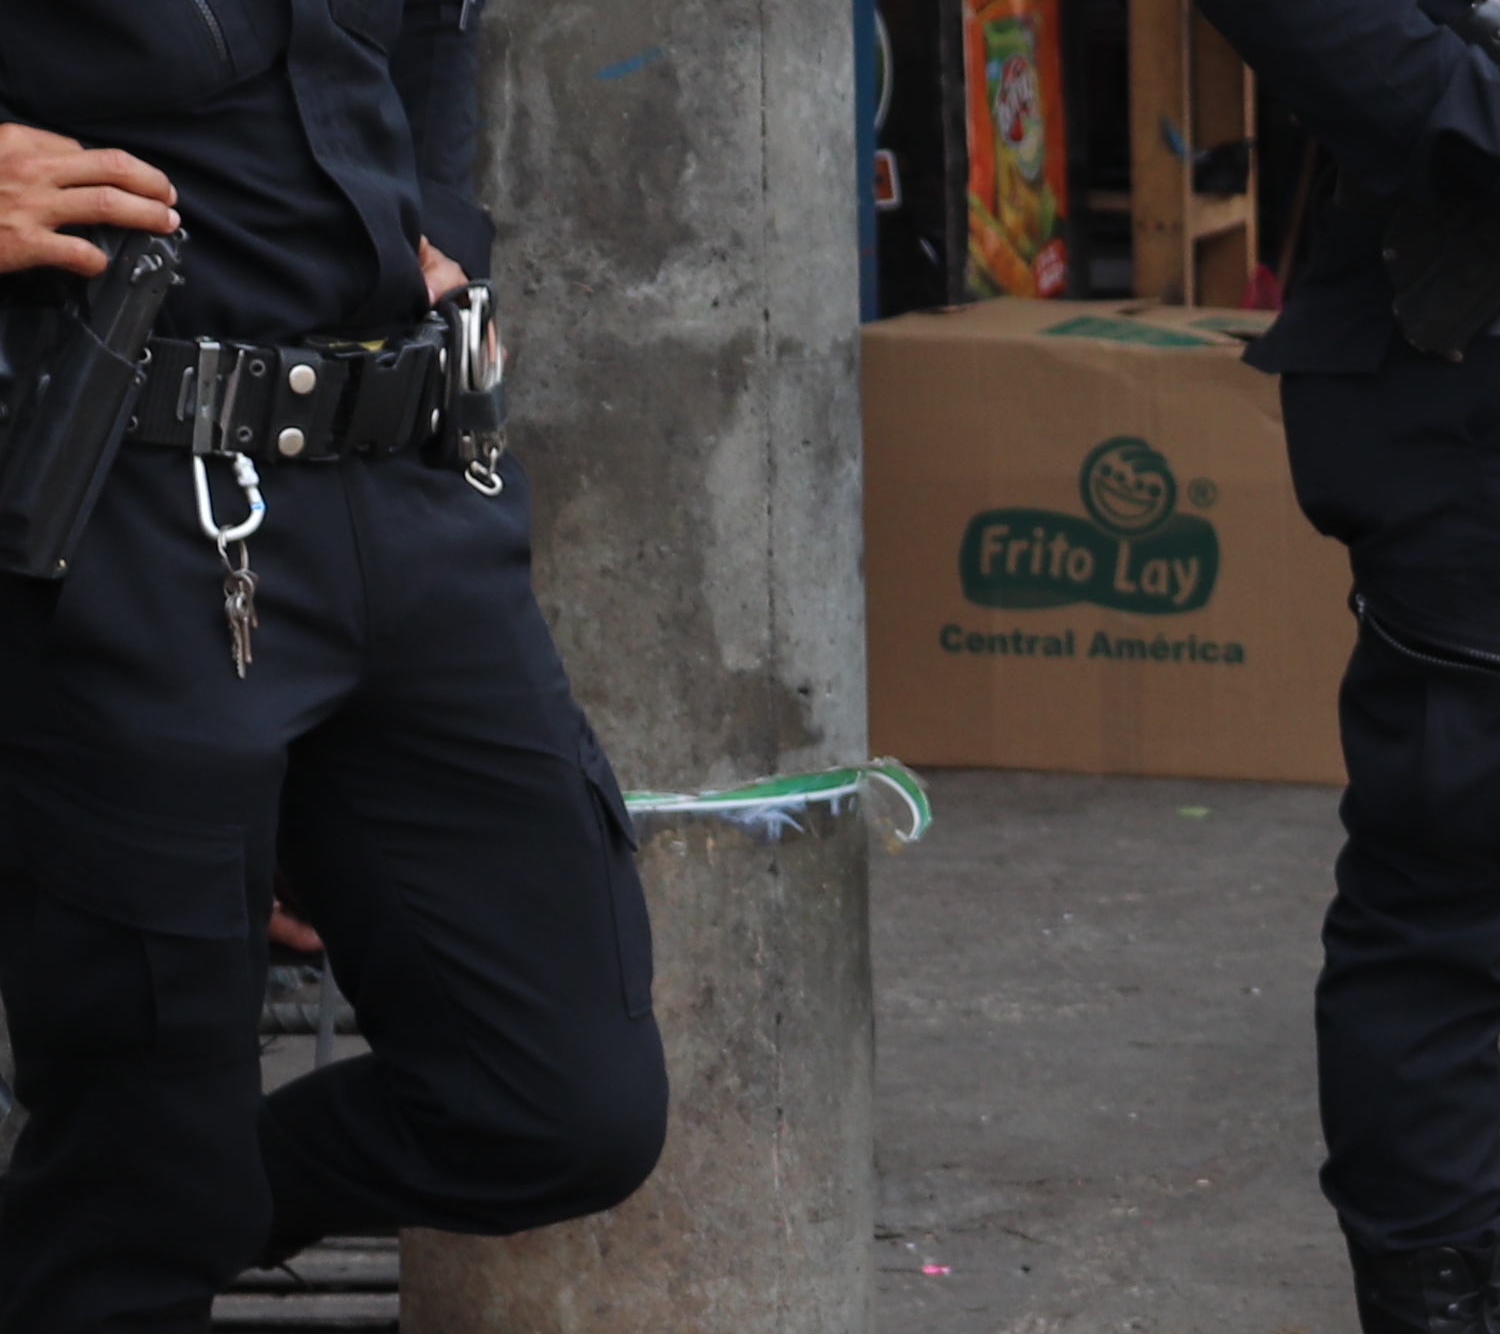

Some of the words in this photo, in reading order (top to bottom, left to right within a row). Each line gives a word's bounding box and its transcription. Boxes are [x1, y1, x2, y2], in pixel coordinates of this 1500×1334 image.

[979, 524, 1095, 583] Frito
[1112, 539, 1200, 607] Lay
[938, 623, 1076, 658] Central
[1087, 629, 1246, 665] América
